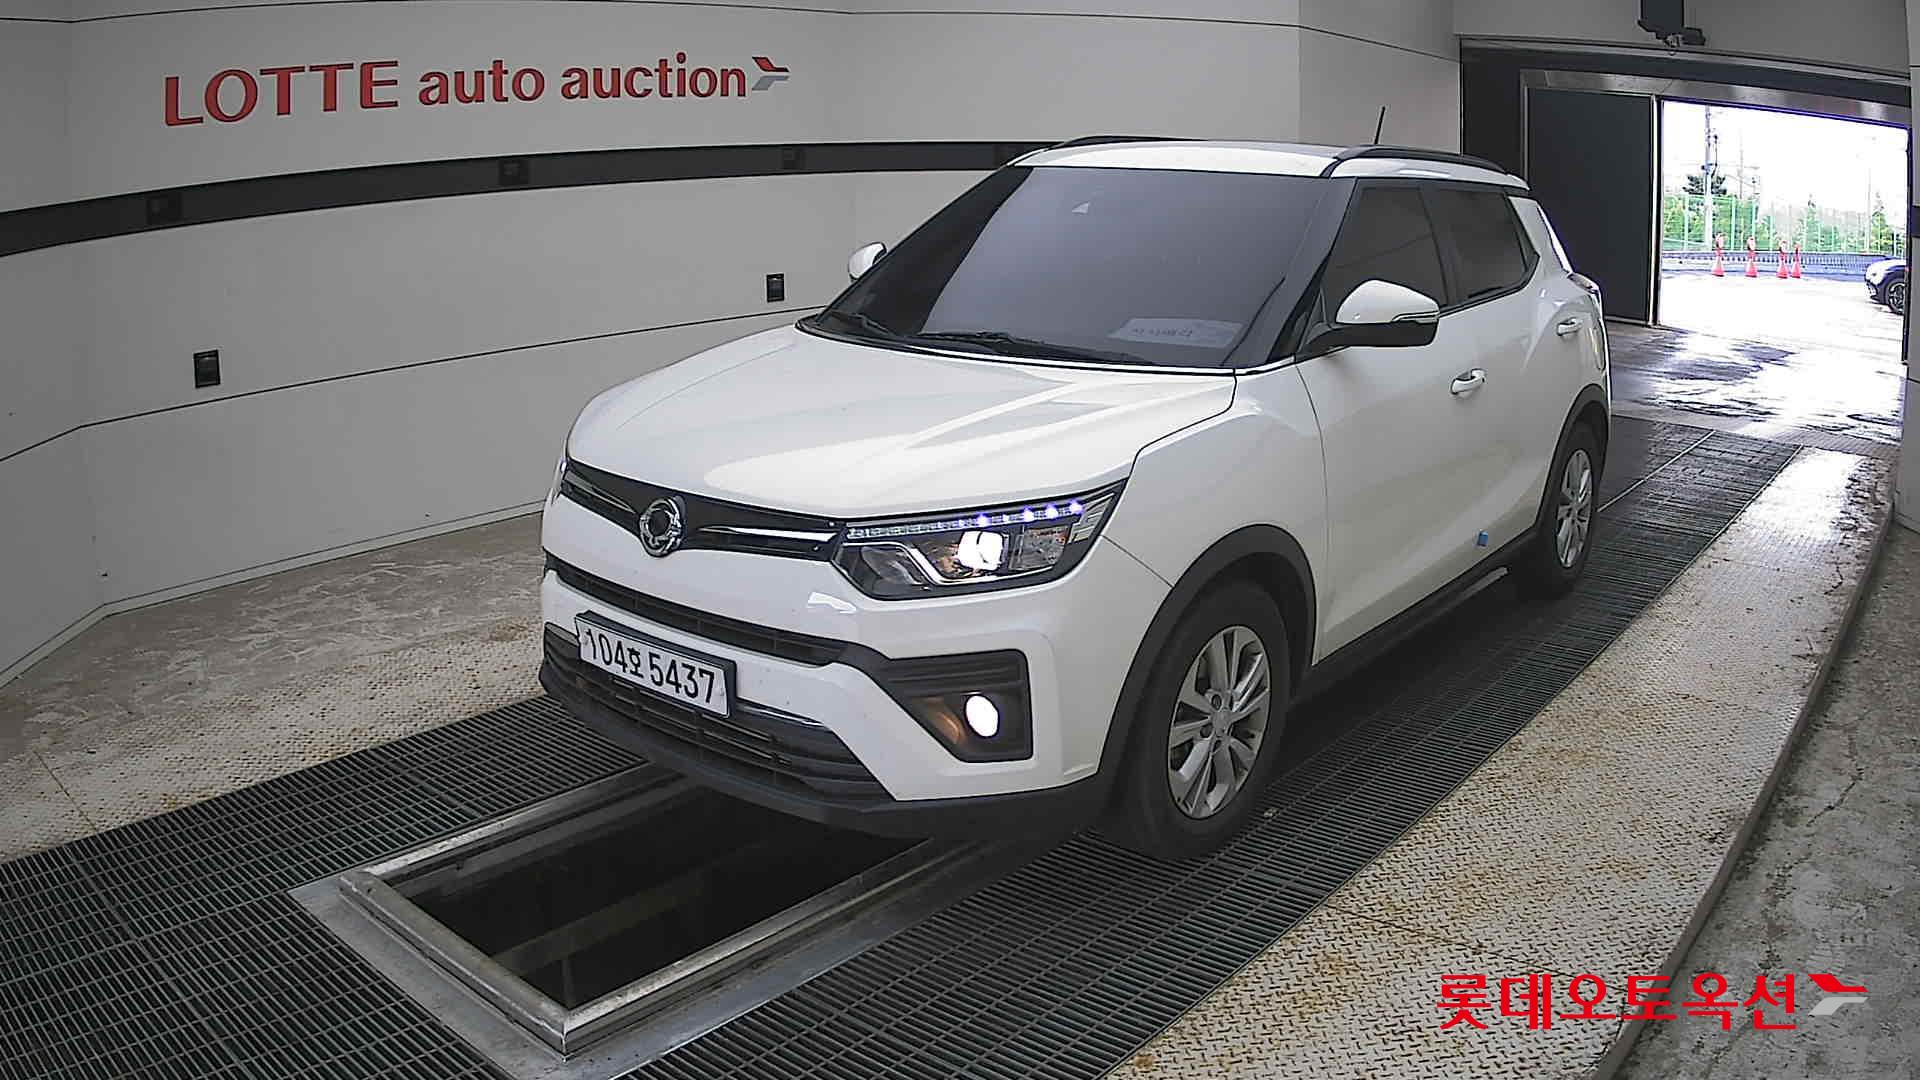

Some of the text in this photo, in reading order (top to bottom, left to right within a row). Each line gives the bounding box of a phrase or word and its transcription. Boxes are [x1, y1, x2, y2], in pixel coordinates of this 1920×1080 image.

[164, 51, 747, 126] LOTTE auto auction
[649, 652, 715, 703] 5437
